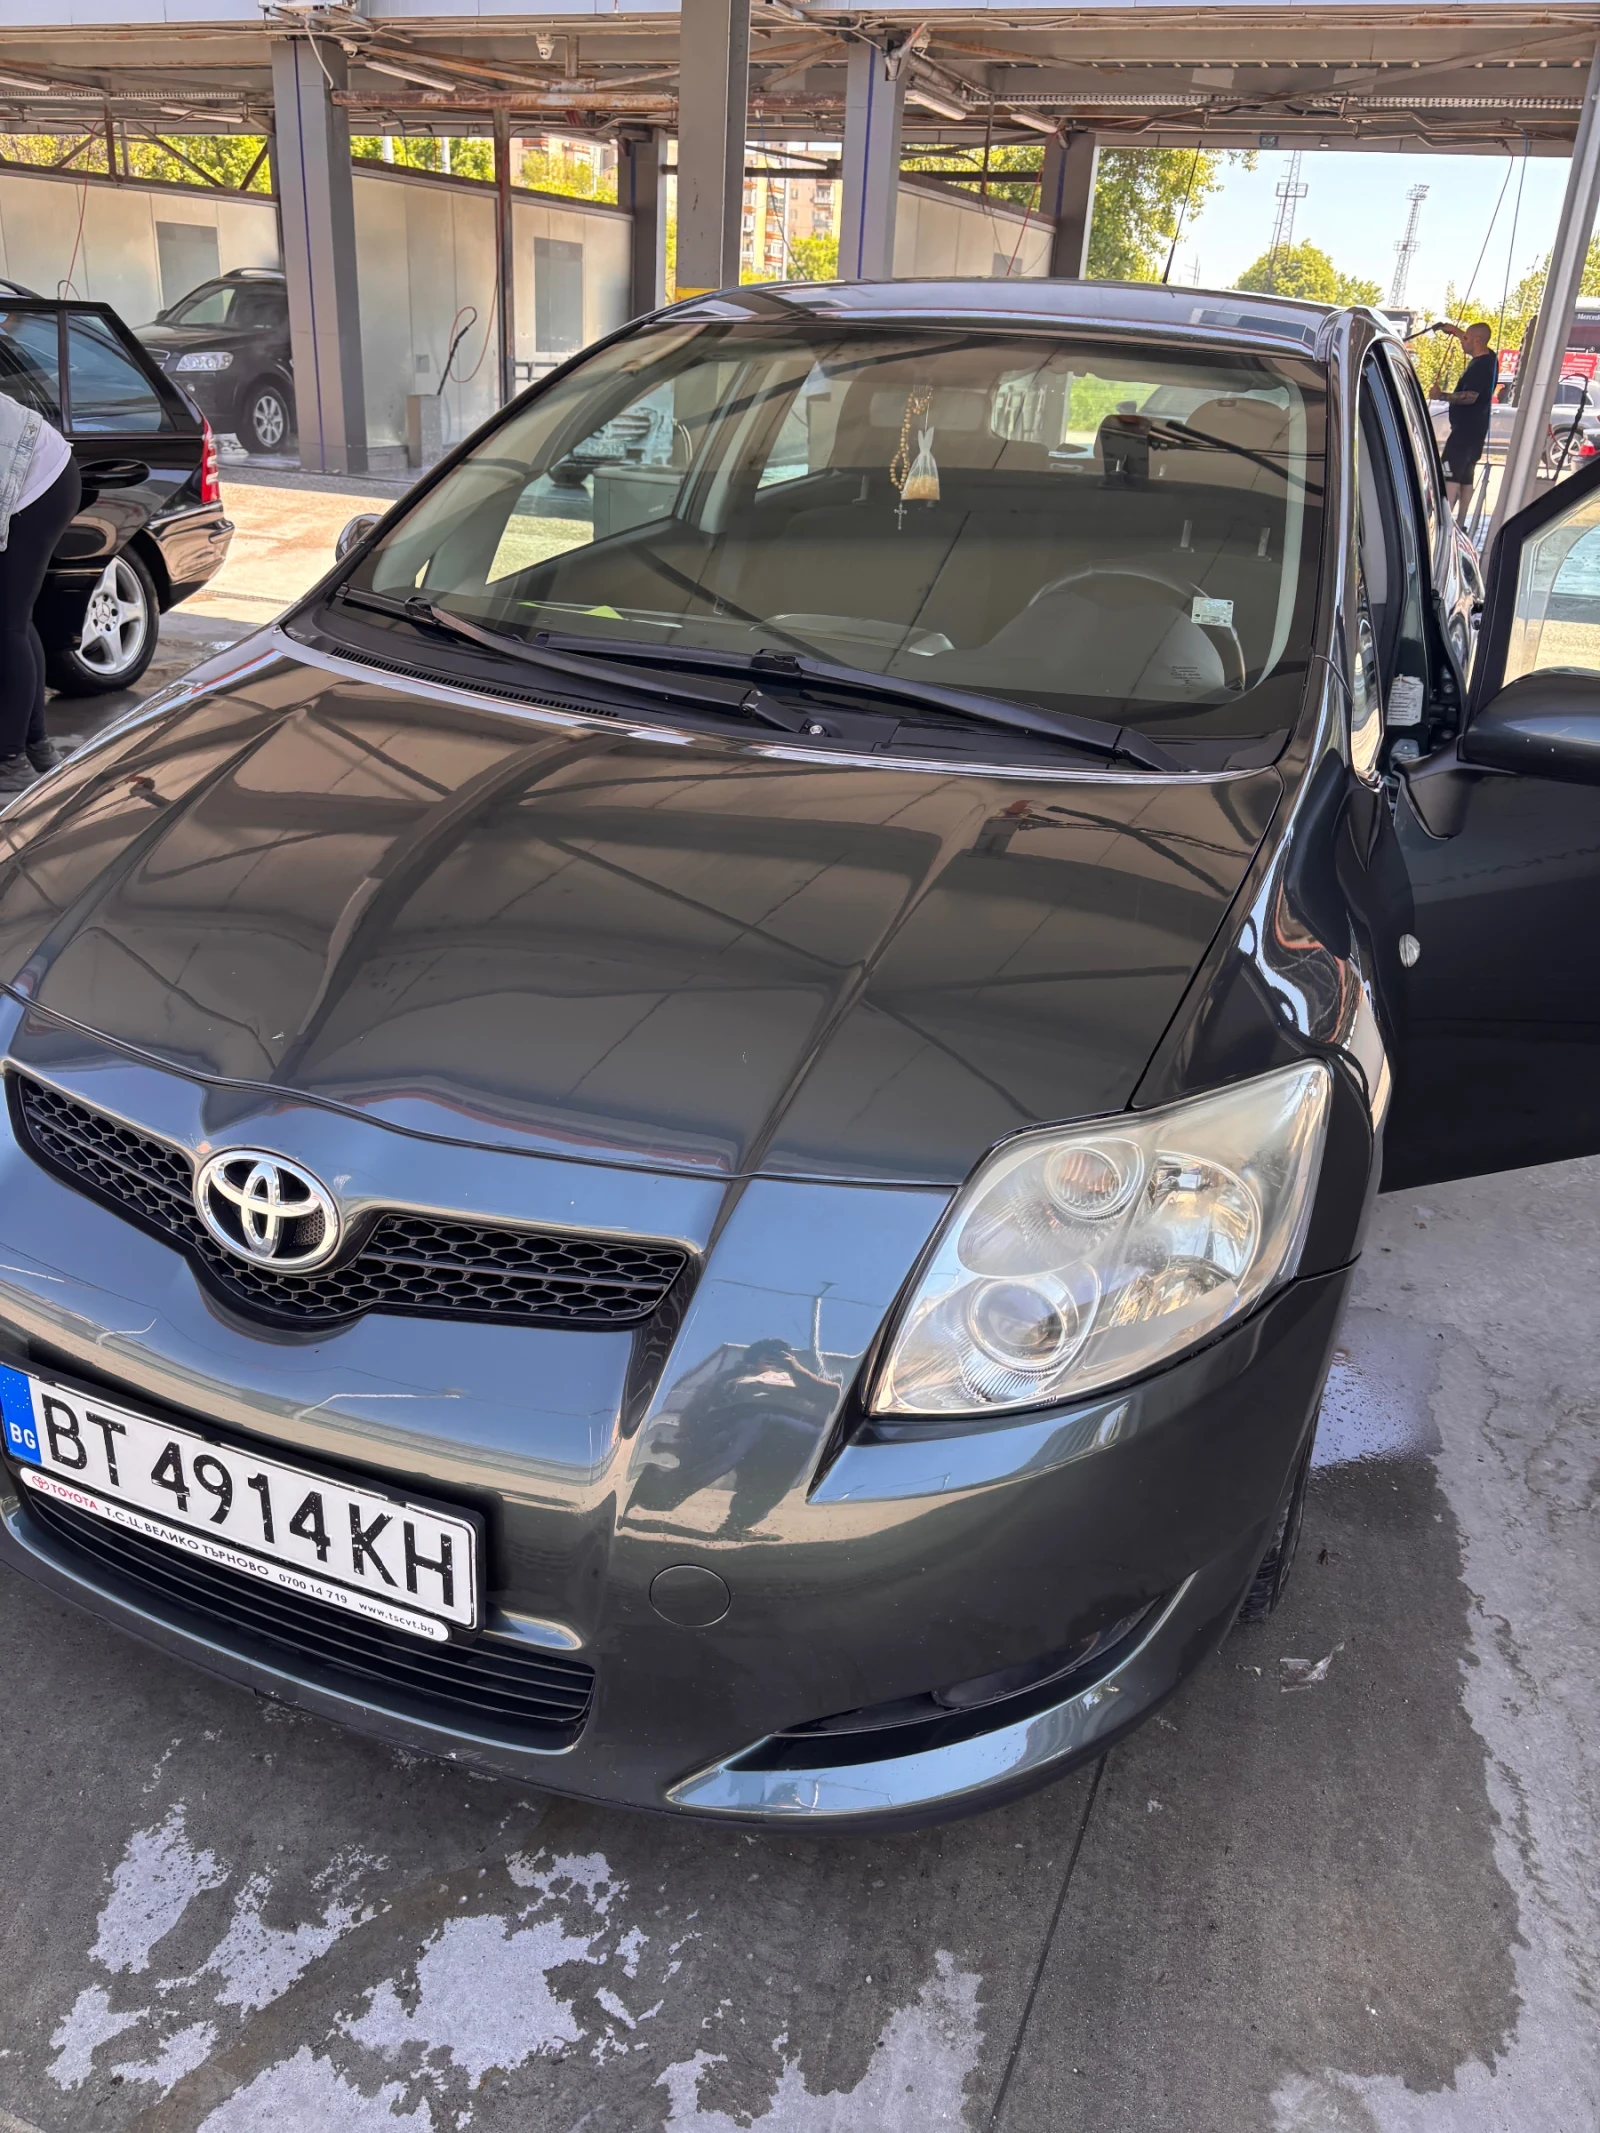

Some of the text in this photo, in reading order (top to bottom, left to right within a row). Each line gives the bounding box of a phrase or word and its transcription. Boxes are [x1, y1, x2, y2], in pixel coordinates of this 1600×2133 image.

[9, 1422, 37, 1450] BG
[50, 1483, 98, 1511] TOYOTA
[145, 1522, 199, 1550] ВЕЛИКО
[202, 1544, 269, 1576] ТЪРНОВО
[279, 1573, 307, 1590] 0700
[310, 1584, 323, 1596] 14
[326, 1589, 348, 1605] 719
[358, 1601, 434, 1636] www.tscvt.bg
